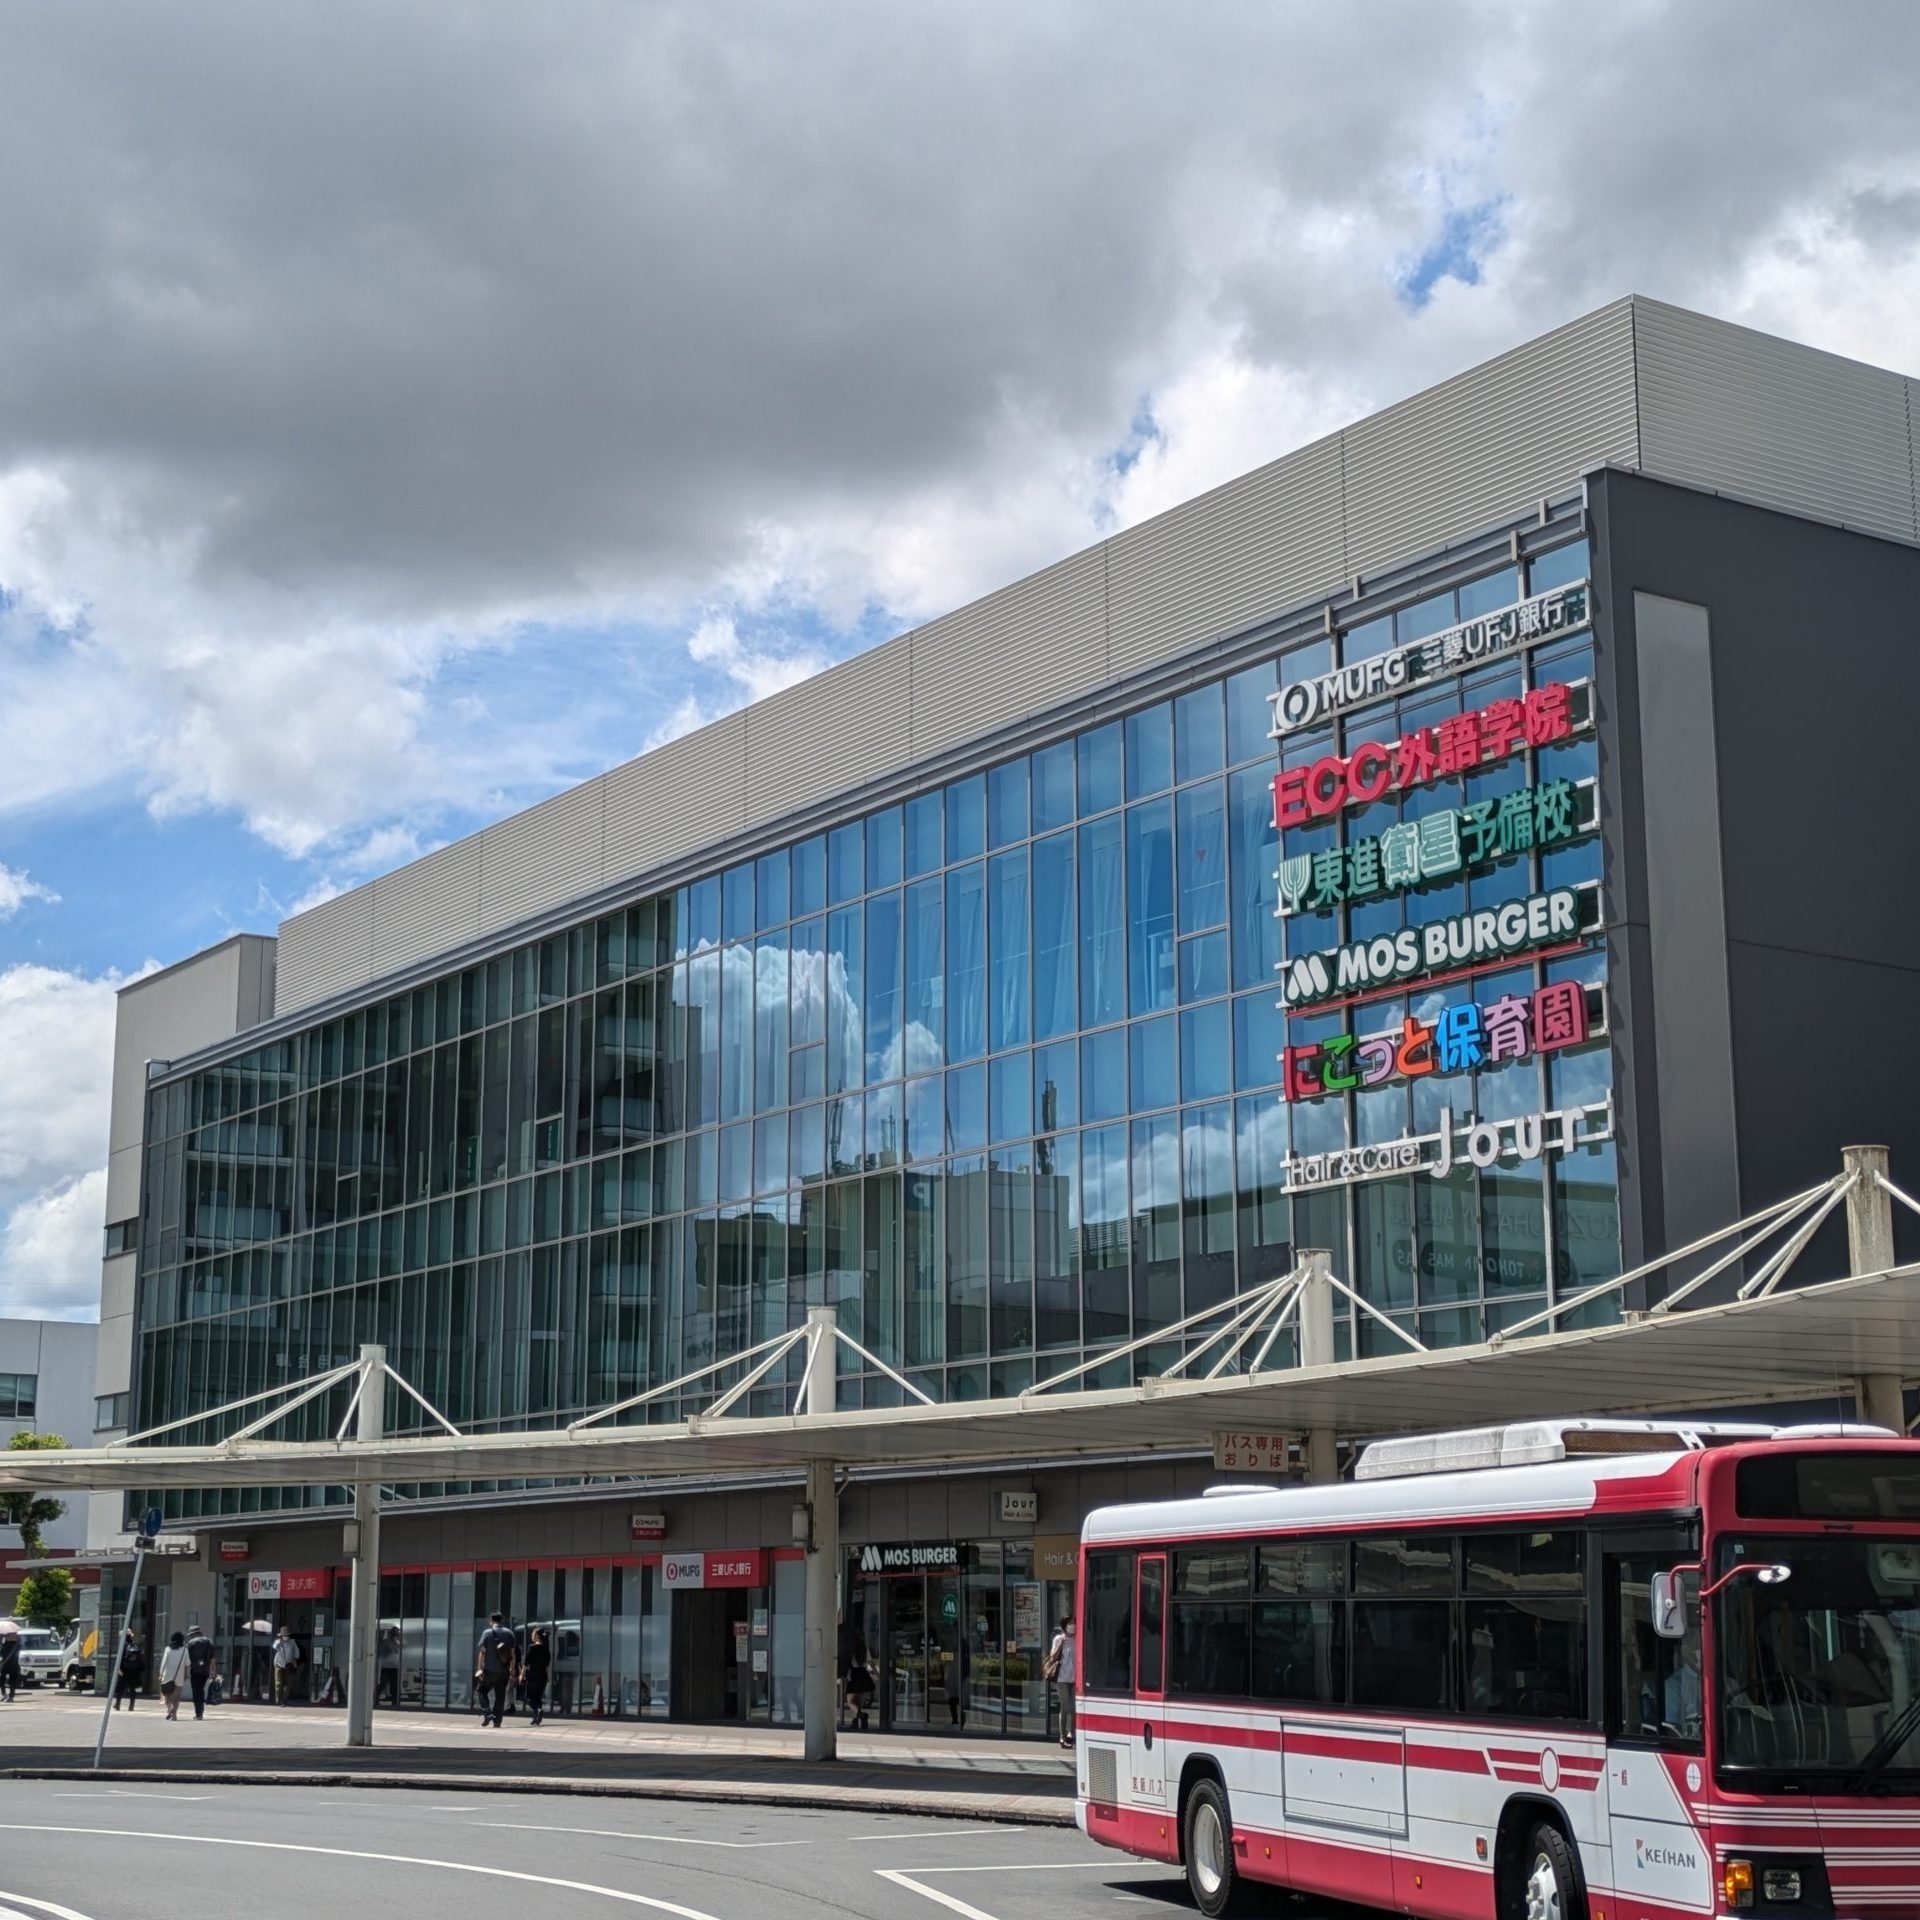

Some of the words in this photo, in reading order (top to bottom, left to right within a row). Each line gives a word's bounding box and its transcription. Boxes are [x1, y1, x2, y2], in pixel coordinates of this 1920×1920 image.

[1322, 649, 1406, 710] MUFG
[1422, 597, 1565, 672] 三菱UFJ銀行
[1337, 931, 1420, 988] MOS
[1425, 889, 1575, 965] BURGER
[1283, 979, 1589, 1101] にこっと保育園
[1430, 1106, 1586, 1179] Jour
[1225, 1435, 1283, 1451] バス専用
[1225, 1453, 1281, 1467] おりば
[1005, 1496, 1034, 1508] Jour
[884, 1549, 910, 1565] MOS
[912, 1547, 957, 1564] BURGER
[679, 1565, 700, 1577] MUFG
[261, 1579, 278, 1591] MUFG
[1645, 1848, 1696, 1869] KEIHAN
